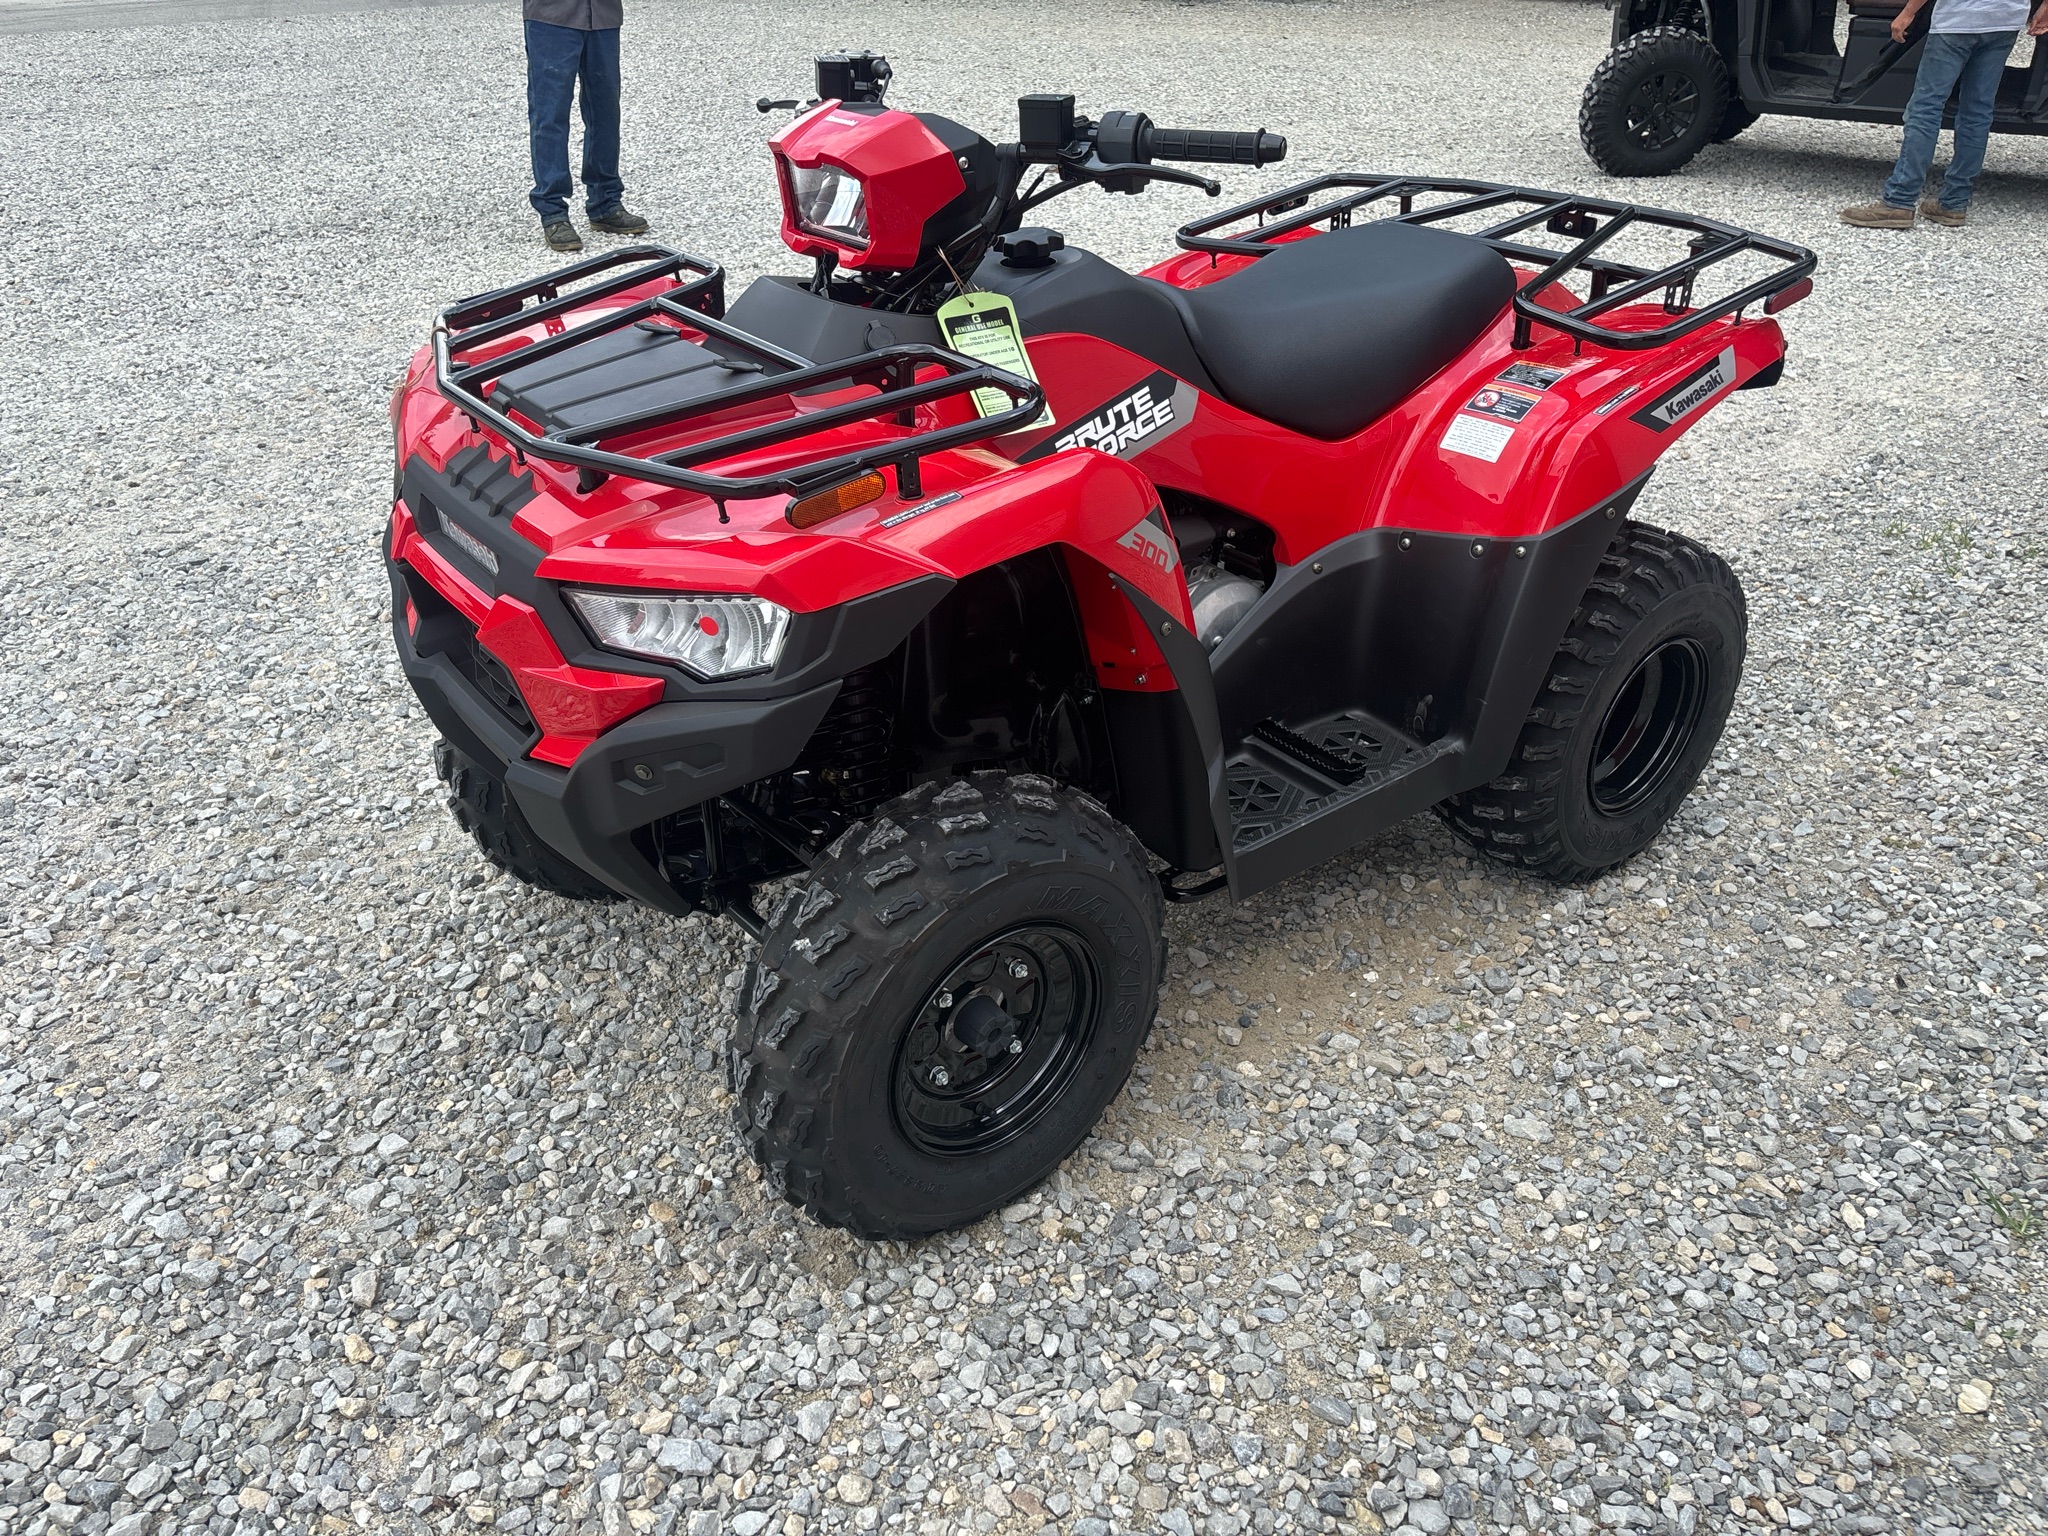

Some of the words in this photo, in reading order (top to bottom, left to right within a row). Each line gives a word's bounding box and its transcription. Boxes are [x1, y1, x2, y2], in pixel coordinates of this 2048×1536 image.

[955, 324, 977, 334] GENERAL
[986, 319, 1004, 328] MODEL
[972, 314, 981, 323] G
[1054, 385, 1155, 453] BRUTE
[1664, 369, 1725, 420] Kawasaki
[1092, 398, 1176, 456] ORCE
[1130, 531, 1169, 572] 300
[1584, 759, 1698, 851] MAXXIS
[1035, 885, 1141, 1034] MAXXIS
